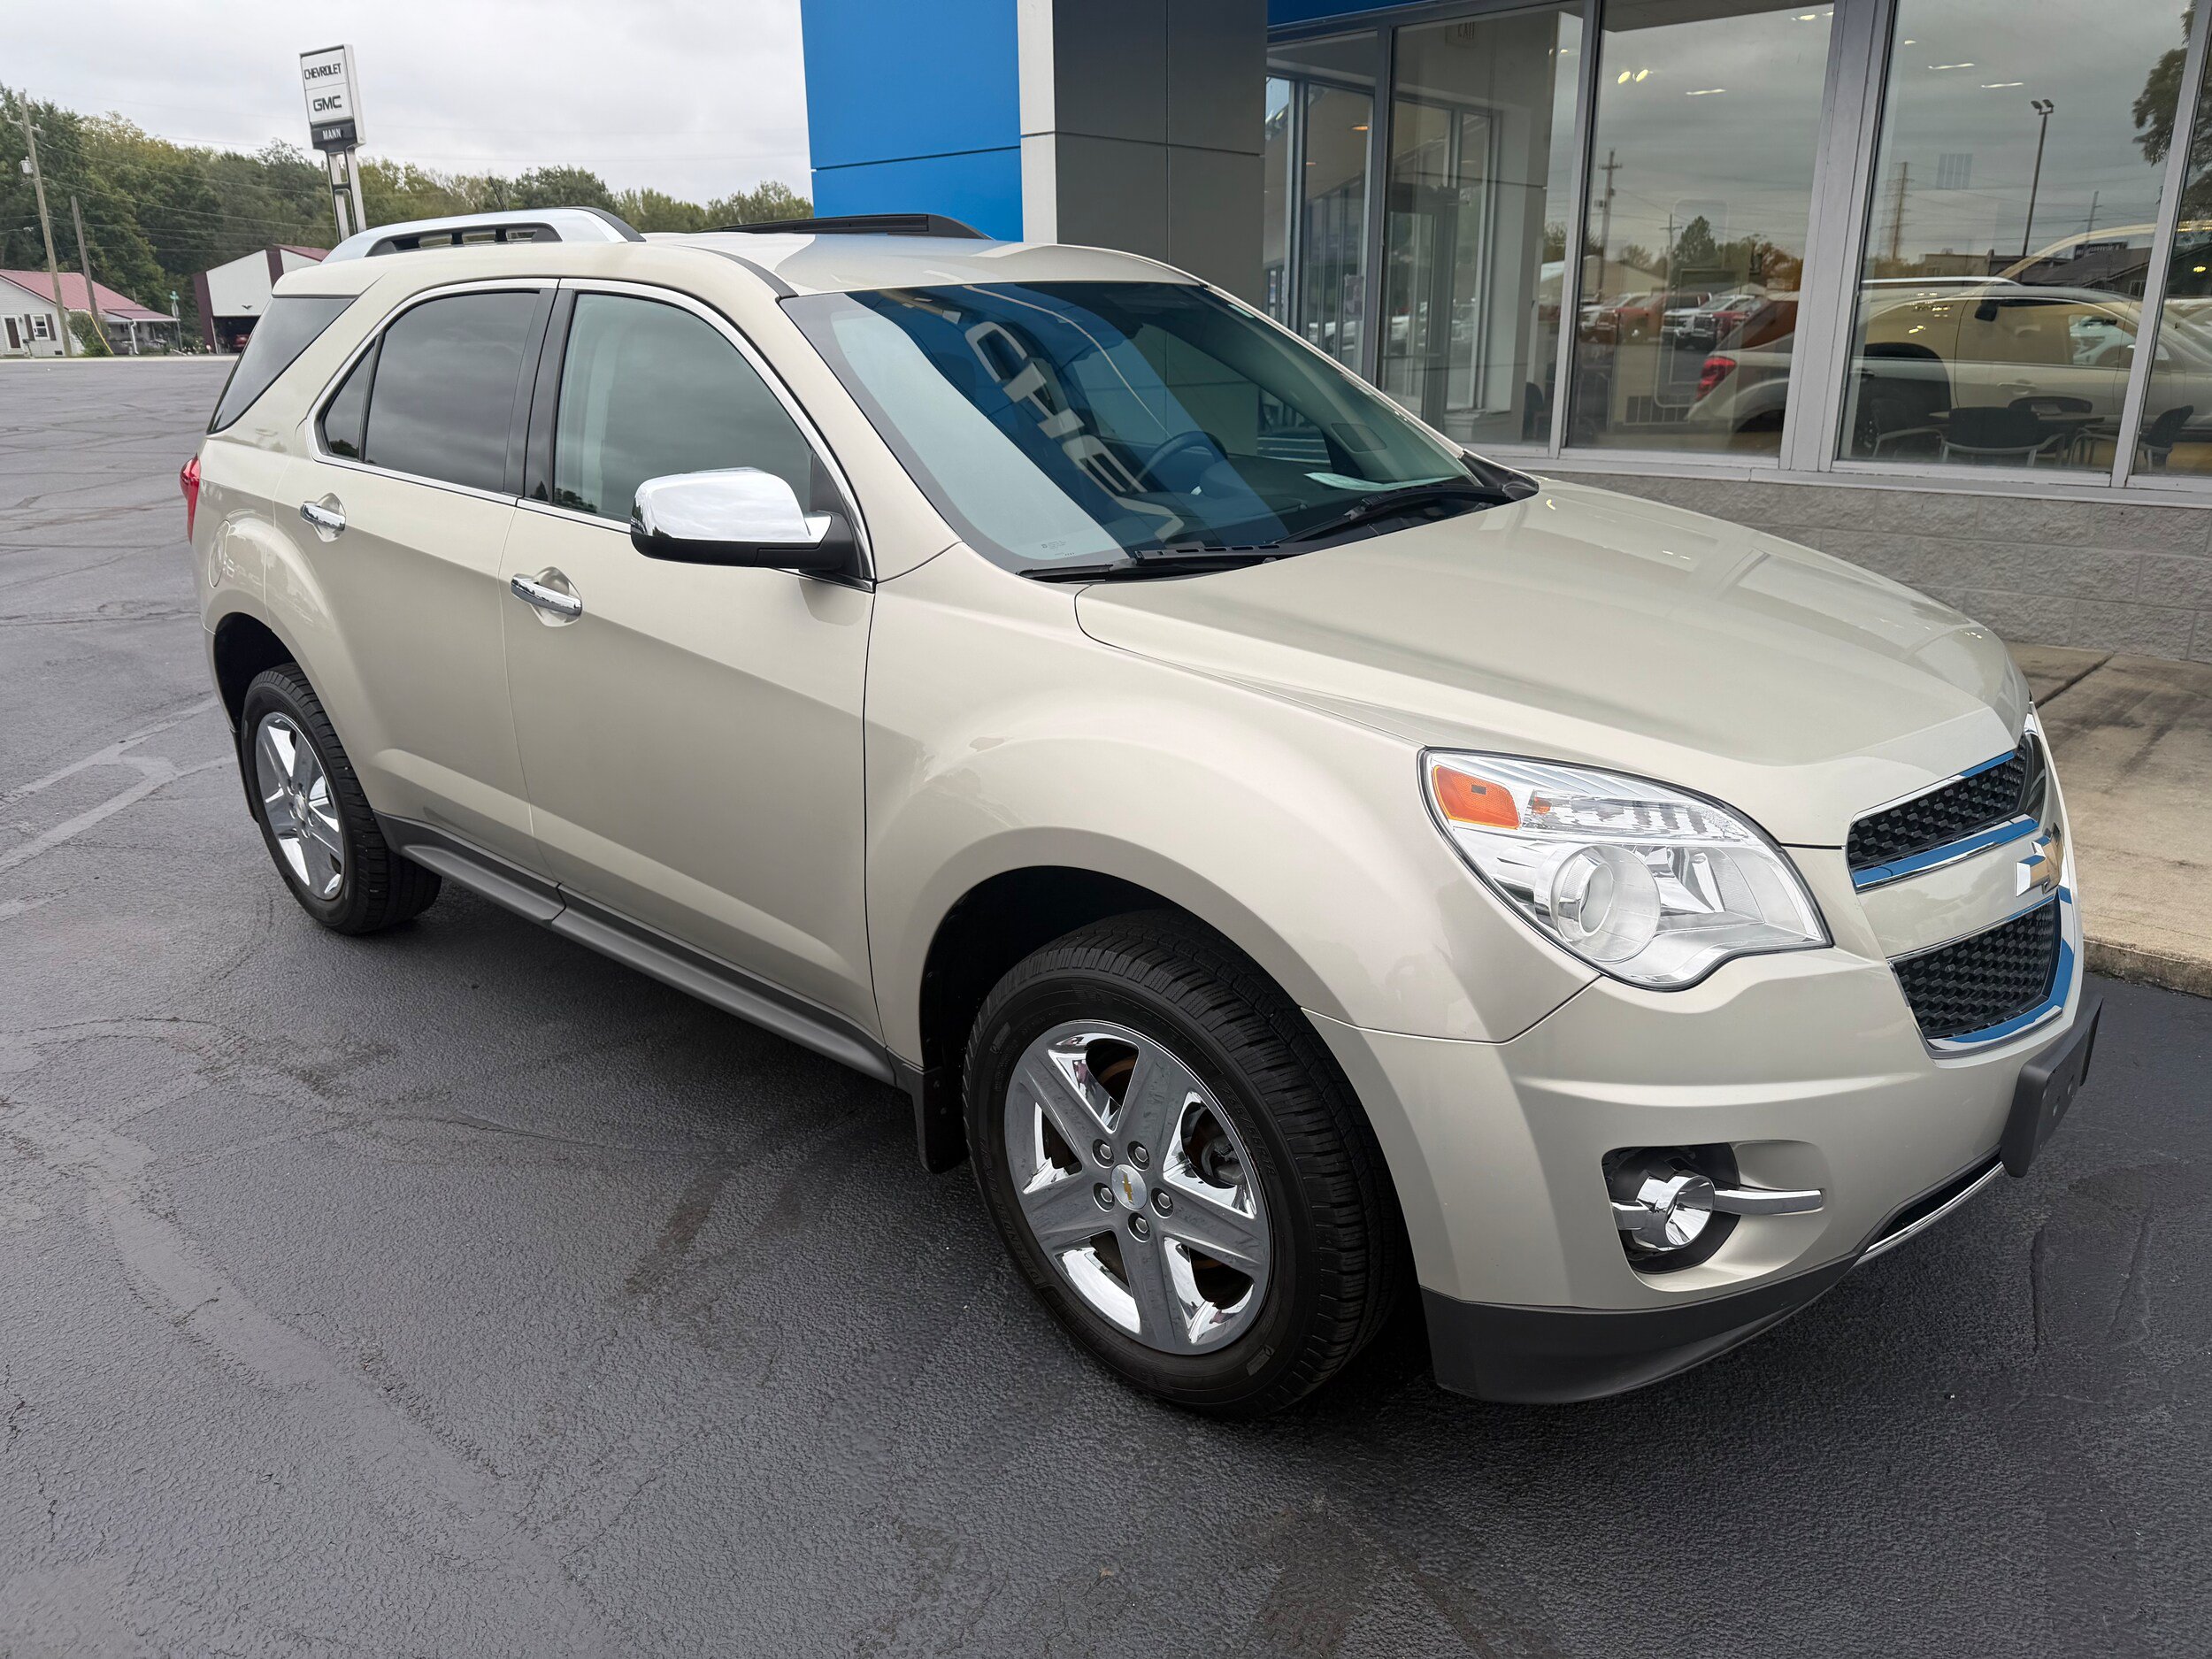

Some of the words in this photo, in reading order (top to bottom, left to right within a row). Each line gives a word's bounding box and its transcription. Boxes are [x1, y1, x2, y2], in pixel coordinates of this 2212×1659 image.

[304, 63, 342, 80] CHEVROLET
[313, 95, 342, 111] GMC
[322, 128, 342, 140] MANN
